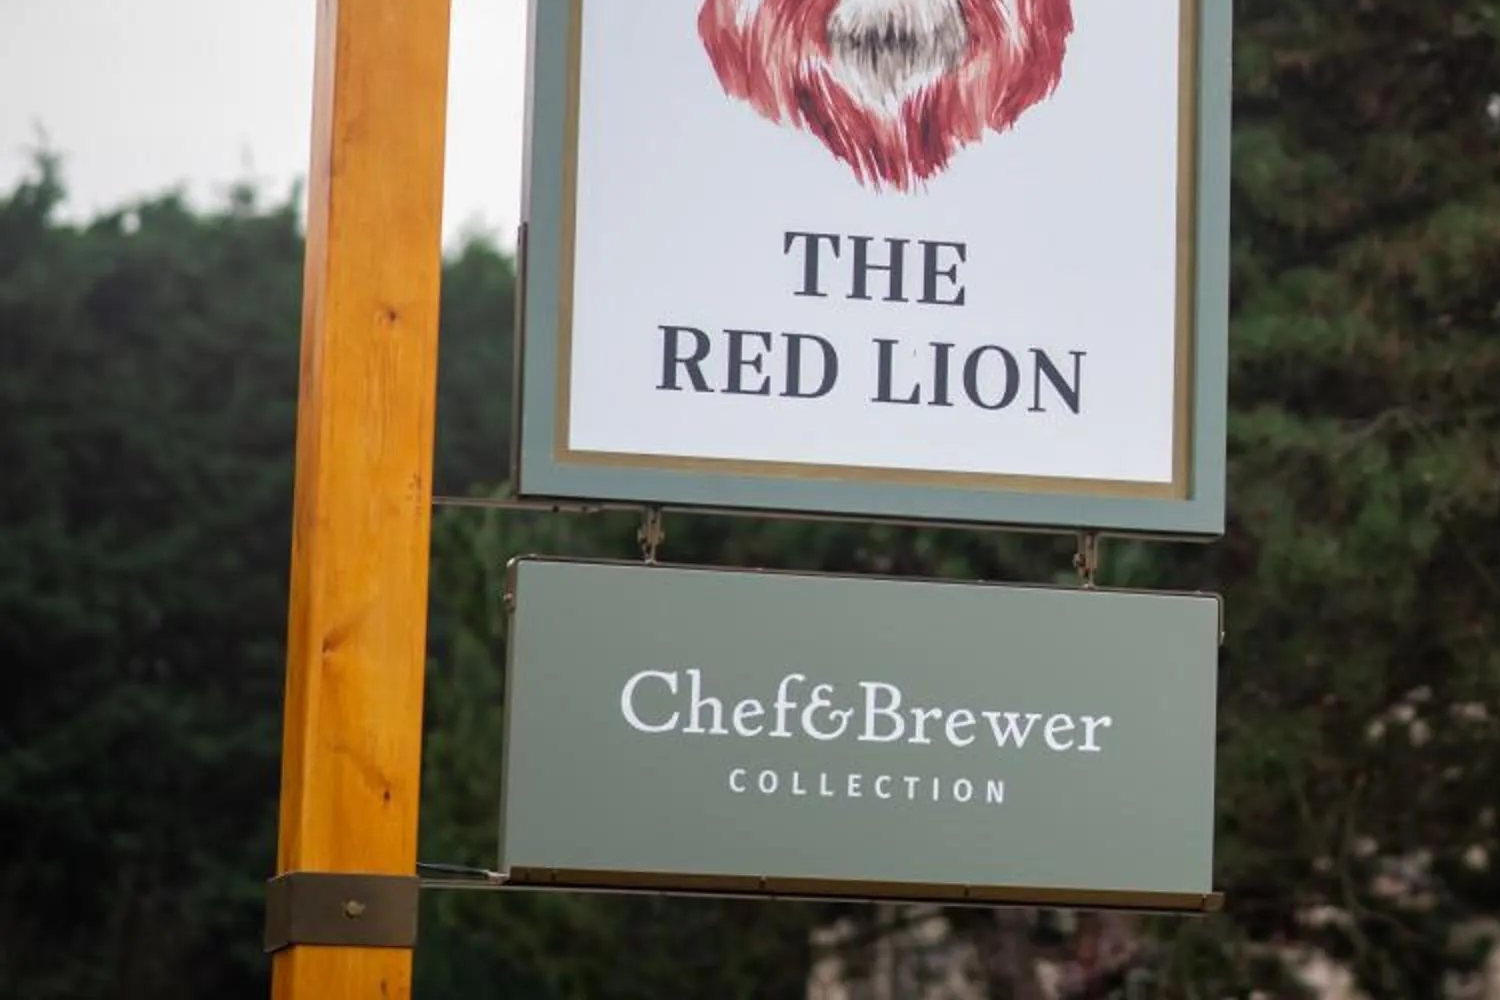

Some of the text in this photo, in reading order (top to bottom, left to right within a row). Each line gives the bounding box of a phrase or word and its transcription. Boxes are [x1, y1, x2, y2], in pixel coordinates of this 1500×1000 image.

[783, 231, 967, 307] THE
[655, 324, 1087, 415] RED LION
[729, 768, 1006, 805] COLLECTION
